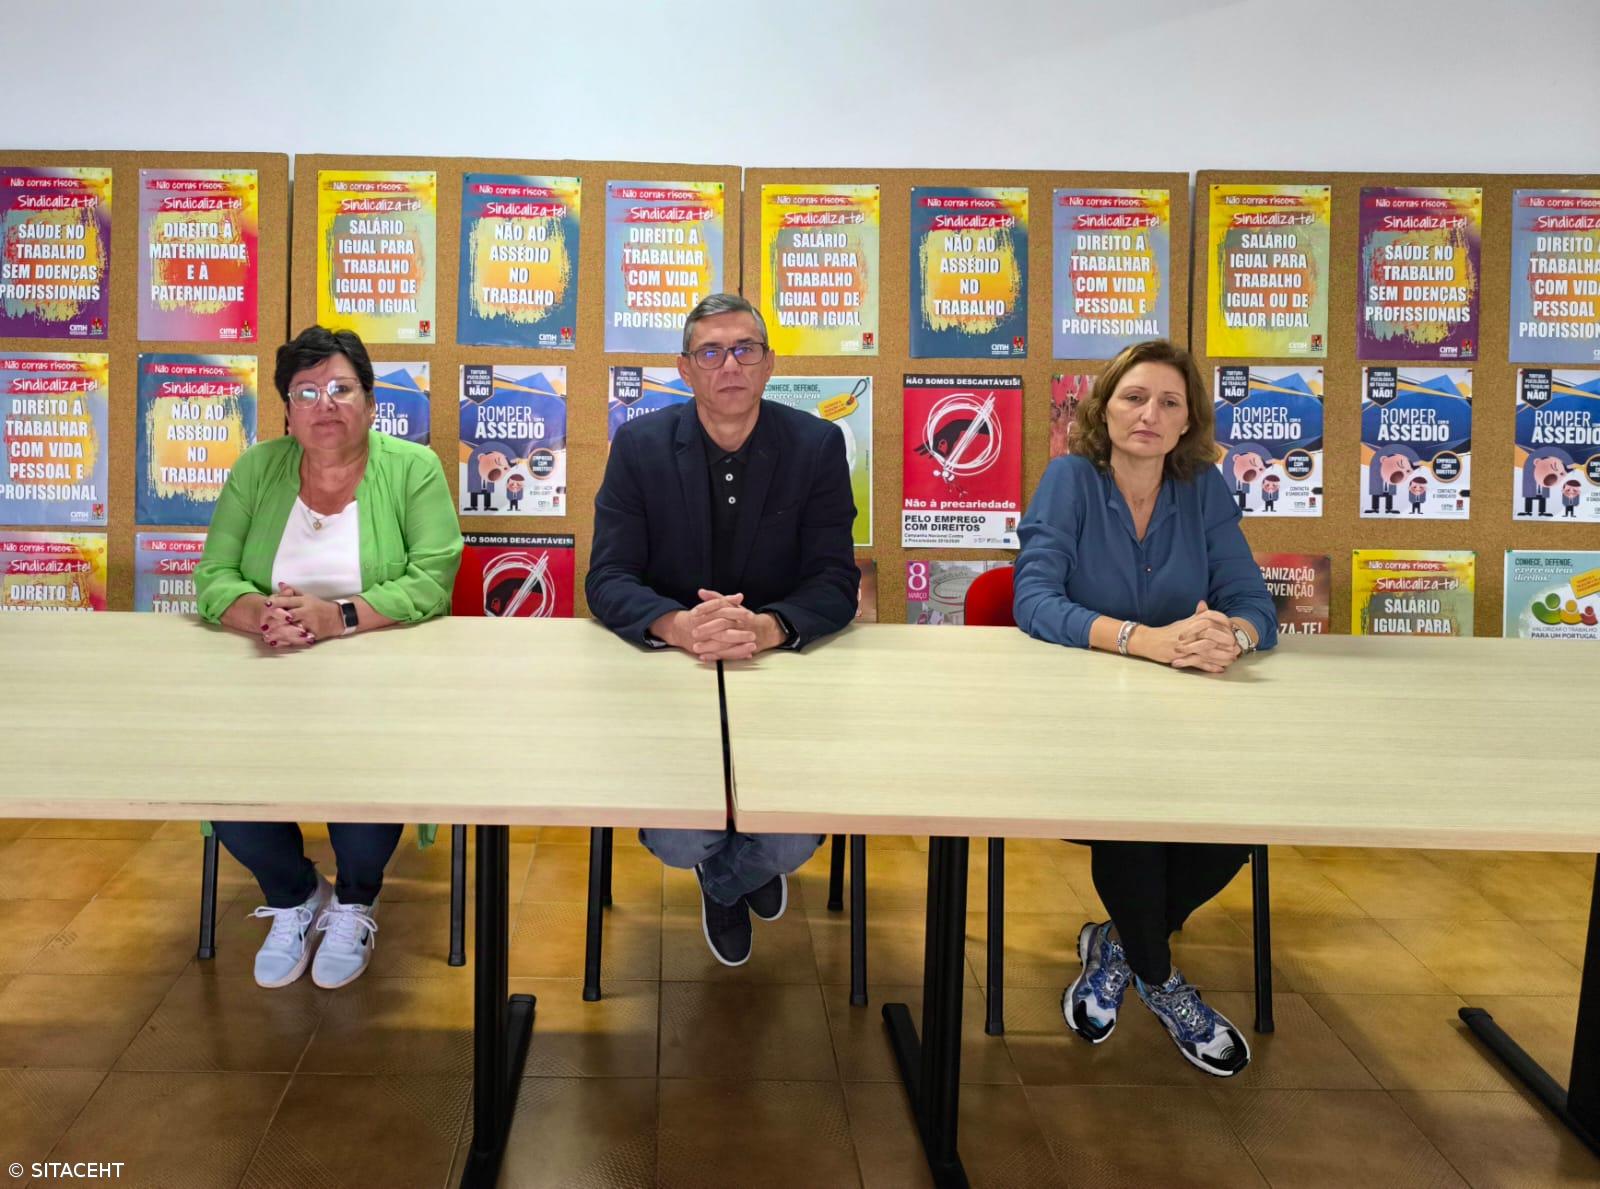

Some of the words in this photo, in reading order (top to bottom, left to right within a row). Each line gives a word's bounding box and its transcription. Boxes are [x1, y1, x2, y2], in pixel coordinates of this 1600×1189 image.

[11, 178, 25, 187] Não
[27, 179, 51, 187] corras
[479, 185, 493, 194] Não
[496, 187, 520, 195] corras
[18, 195, 97, 207] Sindicaliza-te!
[165, 198, 242, 209] Sindicaliza-te!
[342, 199, 421, 211] Sindicaliza-te!
[944, 199, 969, 207] corras
[487, 202, 567, 217] Sindicaliza-te!
[631, 207, 713, 220] Sindicaliza-te!
[350, 217, 403, 235] SALÁRIO
[785, 213, 864, 224] Sindicaliza-te!
[936, 216, 1014, 228] Sindicaliza-te!
[1078, 215, 1159, 227] Sindicaliza-te!
[1234, 213, 1314, 225] Sindicaliza-te!
[1384, 217, 1467, 228] Sindicaliza-te!
[18, 222, 62, 239] SAÚDE
[66, 225, 84, 239] NO
[164, 223, 218, 238] DIREITO
[224, 220, 232, 238] À
[495, 222, 522, 241] NÃO
[528, 226, 546, 241] AO
[630, 228, 683, 244] DIREITO
[689, 230, 698, 244] A
[339, 240, 376, 254] IGUAL
[381, 240, 414, 254] PARA
[793, 231, 847, 248] SALÁRIO
[944, 233, 971, 251] NÃO
[977, 236, 995, 252] AO
[1077, 235, 1130, 250] DIREITO
[1136, 235, 1144, 250] A
[1242, 232, 1296, 248] SALÁRIO
[1537, 237, 1593, 252] DIREITO
[16, 244, 84, 259] TRABALHO
[150, 244, 246, 259] MATERNIDADE
[489, 244, 549, 262] ASSÉDIO
[624, 249, 703, 265] TRABALHAR
[1385, 244, 1429, 260] SAÚDE
[1434, 246, 1452, 260] NO
[343, 260, 409, 274] TRABALHO
[783, 253, 819, 268] IGUAL
[824, 254, 857, 268] PARA
[941, 255, 999, 273] ASSÉDIO
[1072, 256, 1150, 272] TRABALHAR
[1231, 254, 1268, 268] IGUAL
[1273, 255, 1306, 268] PARA
[3, 264, 30, 279] SEM
[36, 265, 97, 282] DOENÇAS
[187, 266, 194, 280] E
[199, 262, 208, 280] À
[509, 268, 528, 283] NO
[629, 271, 660, 285] COM
[666, 272, 698, 285] VIDA
[1383, 266, 1454, 281] TRABALHO
[337, 279, 373, 293] IGUAL
[379, 280, 396, 293] OU
[401, 280, 416, 294] DE
[787, 273, 852, 287] TRABALHO
[960, 279, 980, 294] NO
[1076, 277, 1107, 292] COM
[1113, 277, 1145, 292] VIDA
[1235, 274, 1301, 288] TRABALHO
[1535, 280, 1567, 295] COM
[152, 285, 244, 301] PATERNIDADE
[483, 288, 554, 306] TRABALHO
[628, 291, 687, 307] PESSOAL
[780, 292, 817, 306] IGUAL
[822, 292, 838, 306] OU
[844, 292, 860, 306] DE
[1227, 293, 1265, 307] IGUAL
[1270, 294, 1287, 307] OU
[1292, 294, 1308, 307] DE
[1369, 286, 1397, 301] SEM
[1403, 287, 1466, 304] DOENÇAS
[335, 299, 375, 312] VALOR
[380, 299, 416, 312] IGUAL
[934, 299, 1005, 315] TRABALHO
[1075, 299, 1133, 314] PESSOAL
[1140, 299, 1145, 314] E
[1534, 302, 1595, 316] PESSOAL
[779, 312, 818, 325] VALOR
[823, 312, 860, 326] IGUAL
[1225, 313, 1265, 327] VALOR
[1271, 313, 1310, 327] IGUAL
[1366, 307, 1470, 322] PROFISSIONAIS
[1062, 319, 1159, 335] PROFISSIONAL
[4, 361, 19, 369] Não
[13, 379, 97, 391] Sindicaliza-te!
[906, 376, 923, 384] NÃO
[163, 382, 243, 395] Sindicaliza-te!
[469, 386, 489, 396] NÃO!
[1225, 387, 1245, 397] NÃO!
[1373, 389, 1392, 398] NÃO!
[1527, 390, 1547, 400] NÃO!
[12, 400, 67, 415] DIREITO
[73, 400, 82, 415] A
[172, 401, 200, 419] NÃO
[205, 404, 224, 419] AO
[478, 406, 532, 421] ROMPER
[1234, 407, 1288, 422] ROMPER
[1381, 409, 1436, 424] ROMPER
[1536, 411, 1590, 426] ROMPER
[6, 420, 87, 436] TRABALHAR
[168, 426, 228, 441] ASSÉDIO
[475, 417, 544, 439] ASSÉDIO
[1230, 420, 1301, 440] ASSÉDIO
[1378, 420, 1449, 441] ASSÉDIO
[11, 442, 43, 457] COM
[49, 442, 82, 458] VIDA
[188, 447, 207, 462] NO
[10, 464, 71, 479] PESSOAL
[77, 464, 83, 478] E
[905, 499, 926, 507] Não
[941, 500, 1015, 510] precariedade
[11, 560, 90, 572] Sindicaliza-te!
[908, 563, 927, 590] 8
[11, 585, 66, 600] DIREITO
[71, 583, 80, 600] À
[1377, 579, 1458, 590] Sindicaliza-te!
[1385, 596, 1440, 614] SALÁRIO
[1374, 619, 1412, 632] IGUAL
[1417, 619, 1451, 632] PARA
